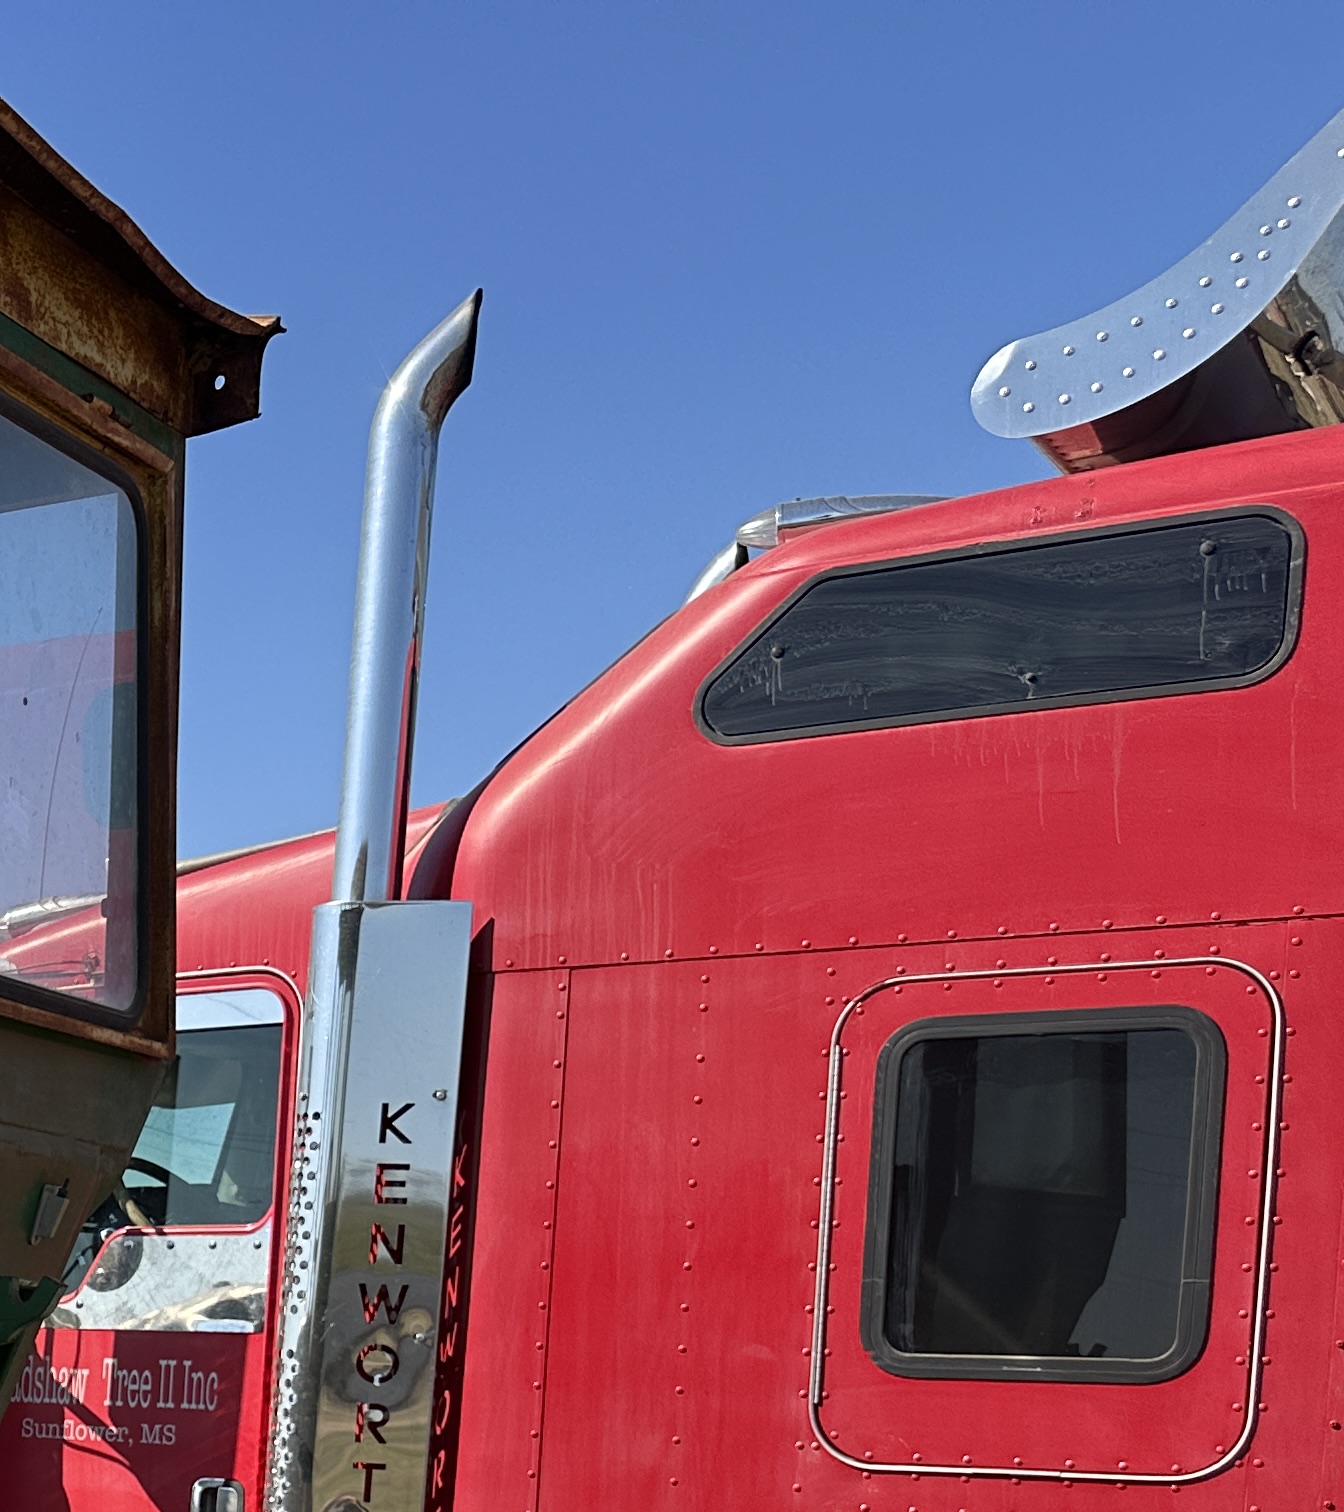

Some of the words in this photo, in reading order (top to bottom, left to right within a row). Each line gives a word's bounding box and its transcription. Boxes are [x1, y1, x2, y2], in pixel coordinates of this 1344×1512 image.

[102, 1357, 152, 1408] Tree
[156, 1359, 176, 1409] II
[180, 1360, 218, 1412] Inc
[21, 1417, 133, 1447] Sunflower,
[140, 1424, 176, 1446] MS
